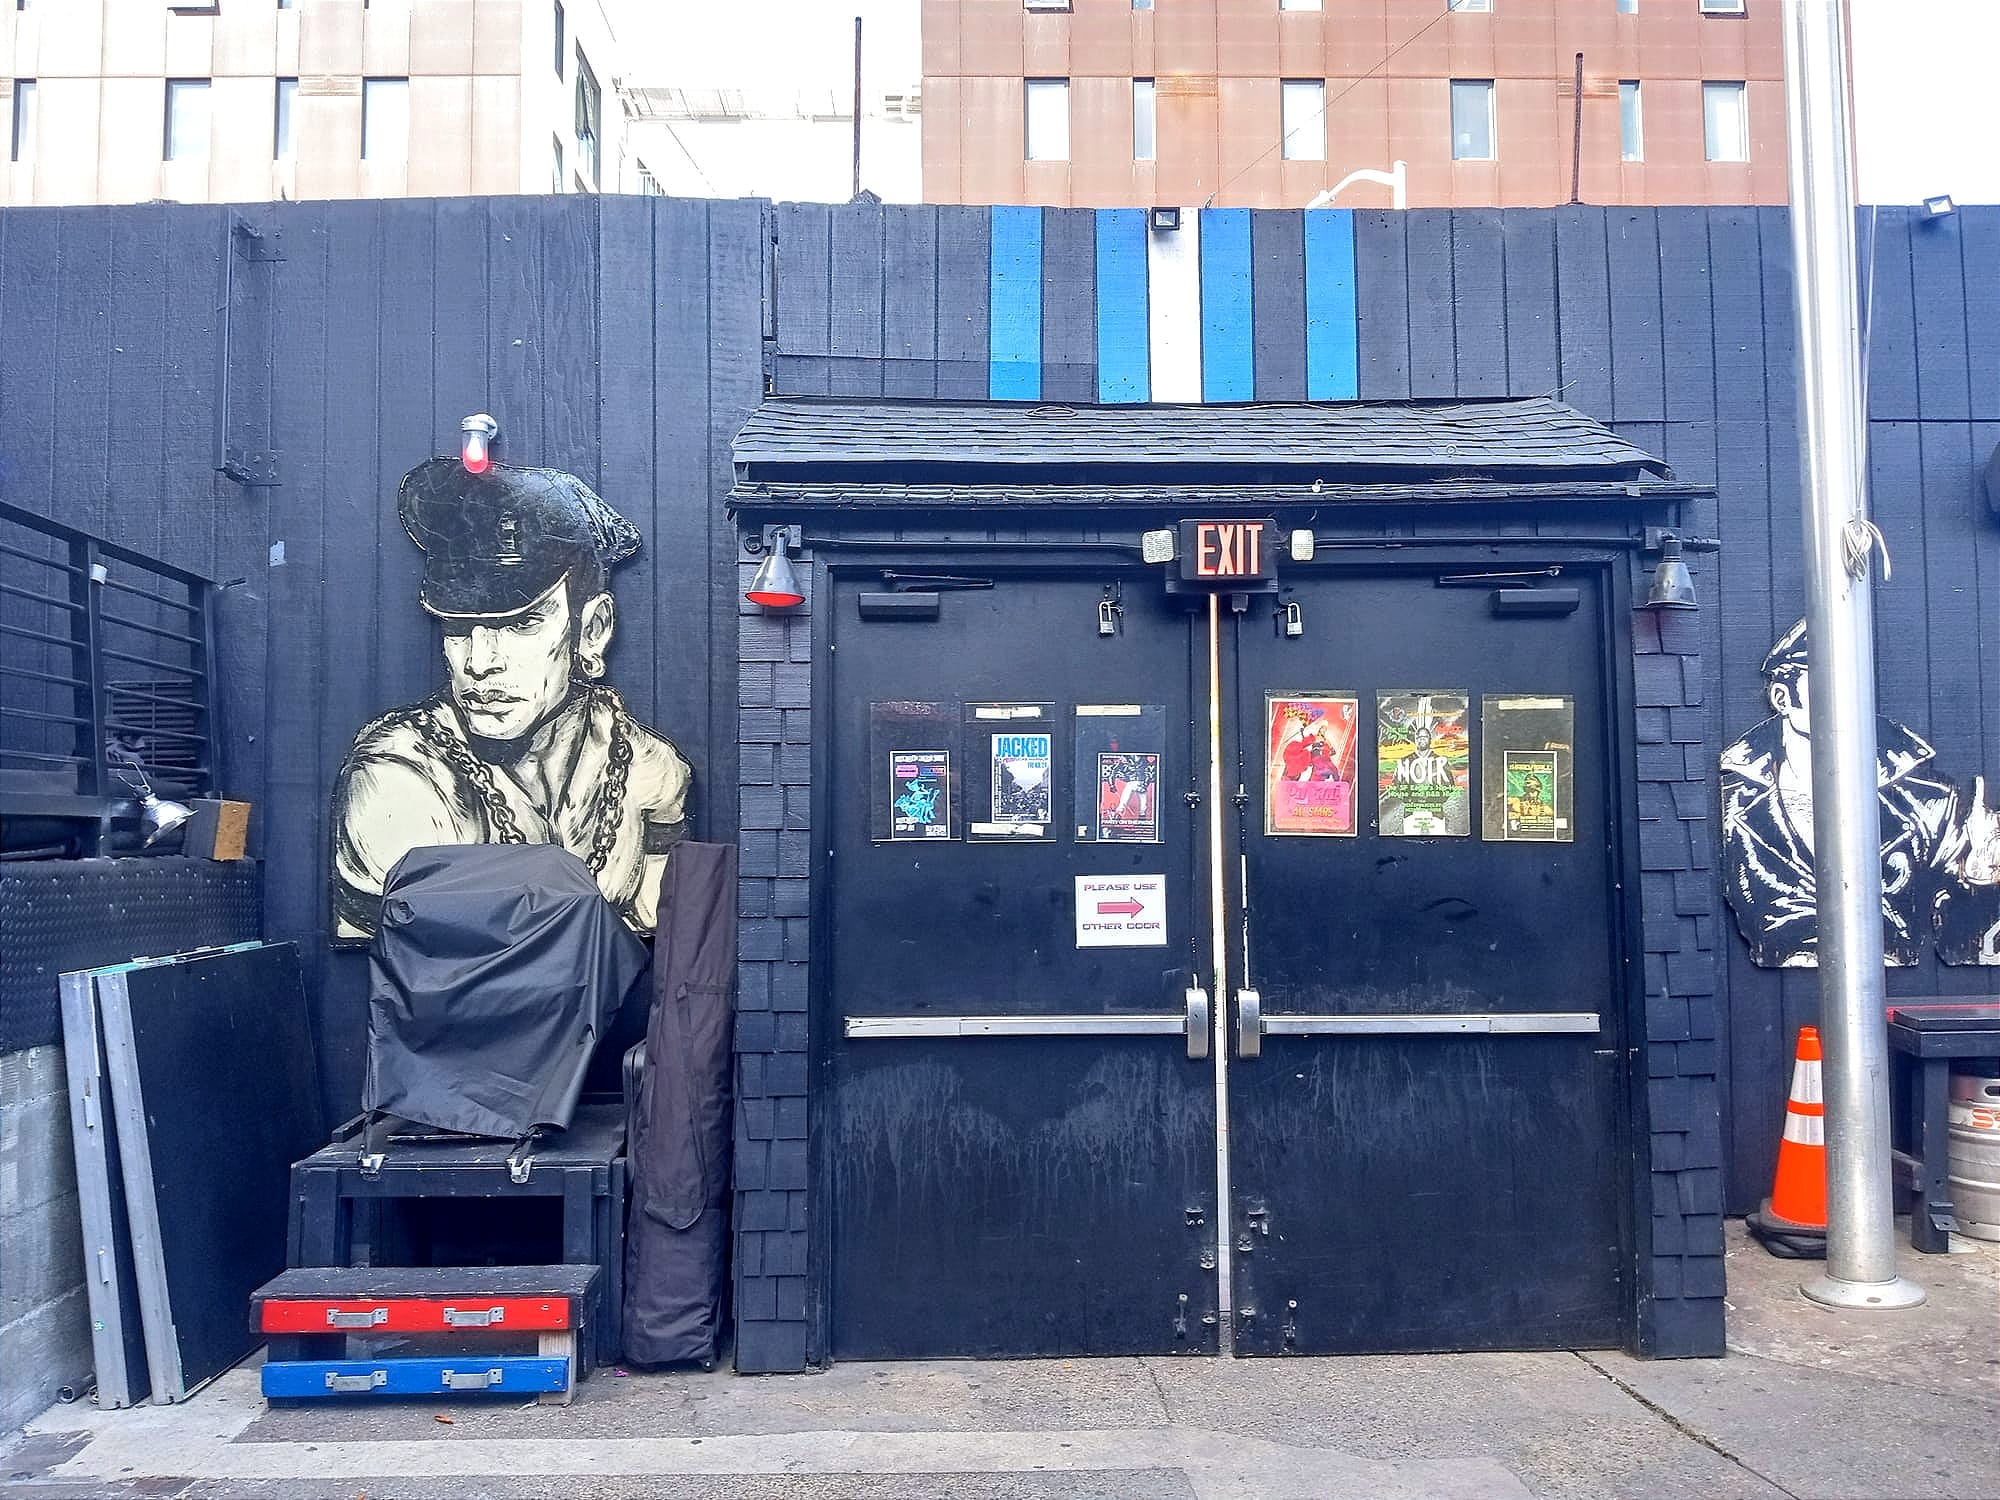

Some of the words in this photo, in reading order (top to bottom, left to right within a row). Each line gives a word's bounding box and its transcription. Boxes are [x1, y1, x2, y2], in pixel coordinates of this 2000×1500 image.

[1196, 522, 1264, 576] EXIT
[996, 737, 1048, 758] JACKED
[1396, 757, 1450, 785] NOIR
[1083, 883, 1130, 891] PLEASE
[1127, 922, 1161, 930] DOOR
